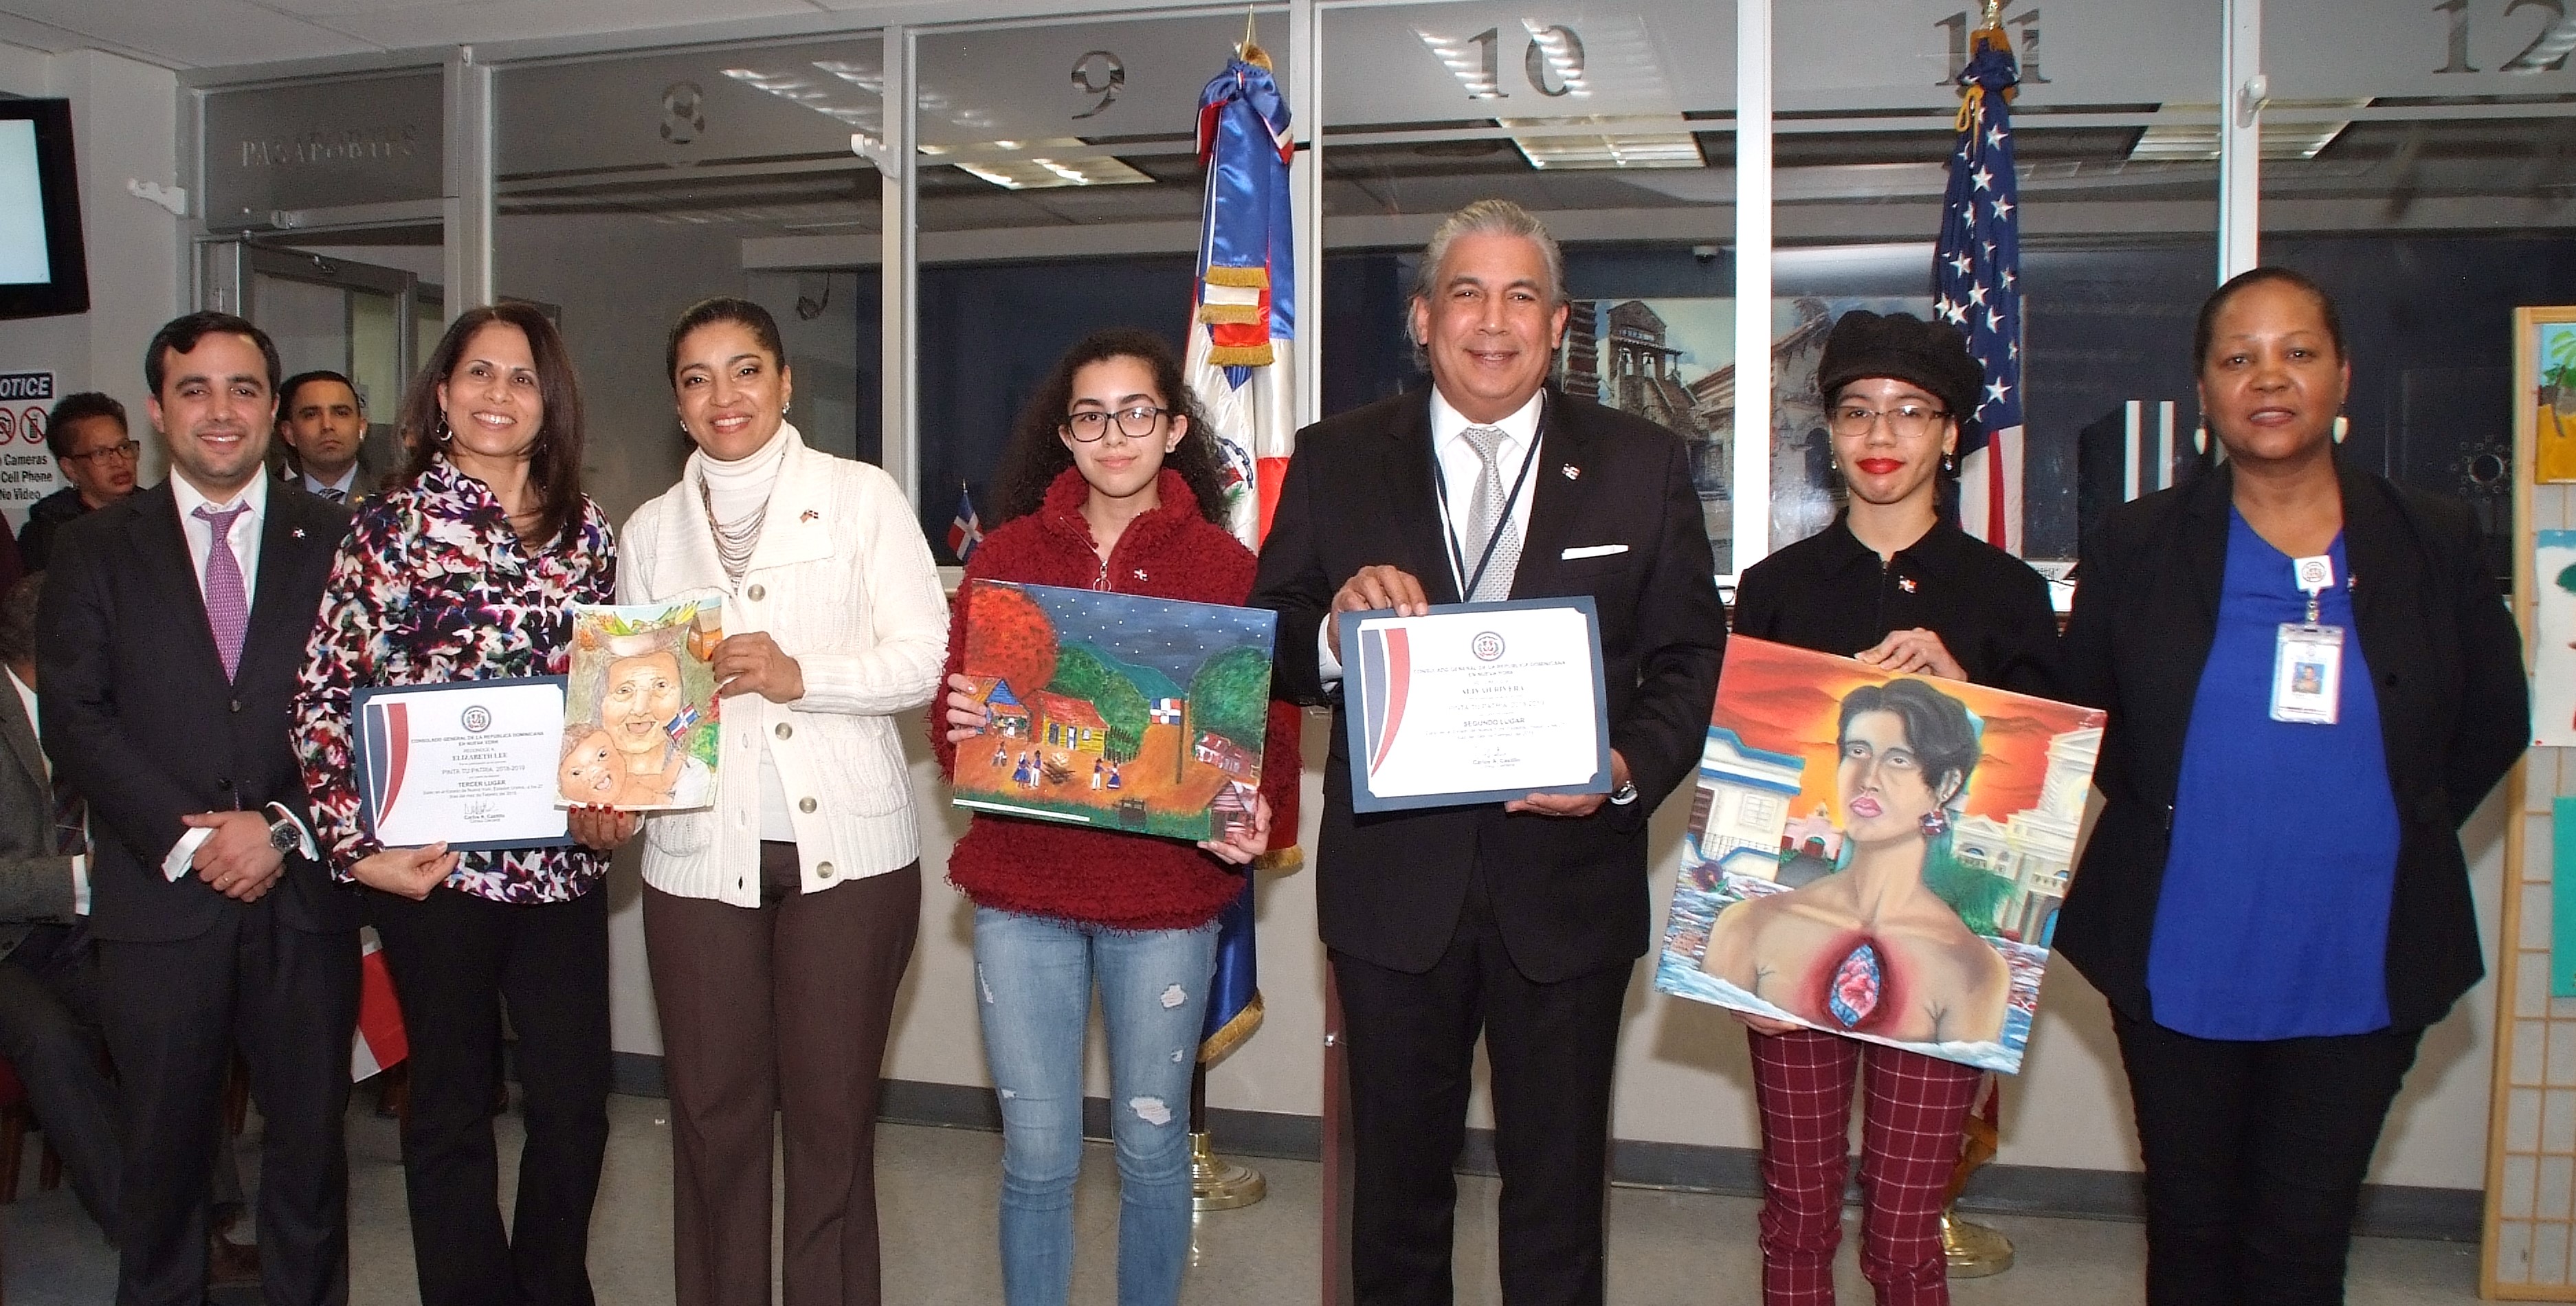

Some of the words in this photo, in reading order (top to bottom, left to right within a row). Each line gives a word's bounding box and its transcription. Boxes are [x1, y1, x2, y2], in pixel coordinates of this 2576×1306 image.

[1935, 8, 2052, 86] 11
[2433, 0, 2570, 74] 12
[1468, 25, 1585, 100] 10
[1070, 49, 1126, 120] 9
[660, 80, 705, 145] 8
[0, 377, 50, 397] OTICE
[1, 470, 20, 483] Cell
[22, 470, 53, 483] Phone
[4, 453, 47, 465] Cameras
[14, 487, 41, 500] Video
[1463, 719, 1498, 727] SEGUNDO
[1500, 717, 1525, 725] LUGAR
